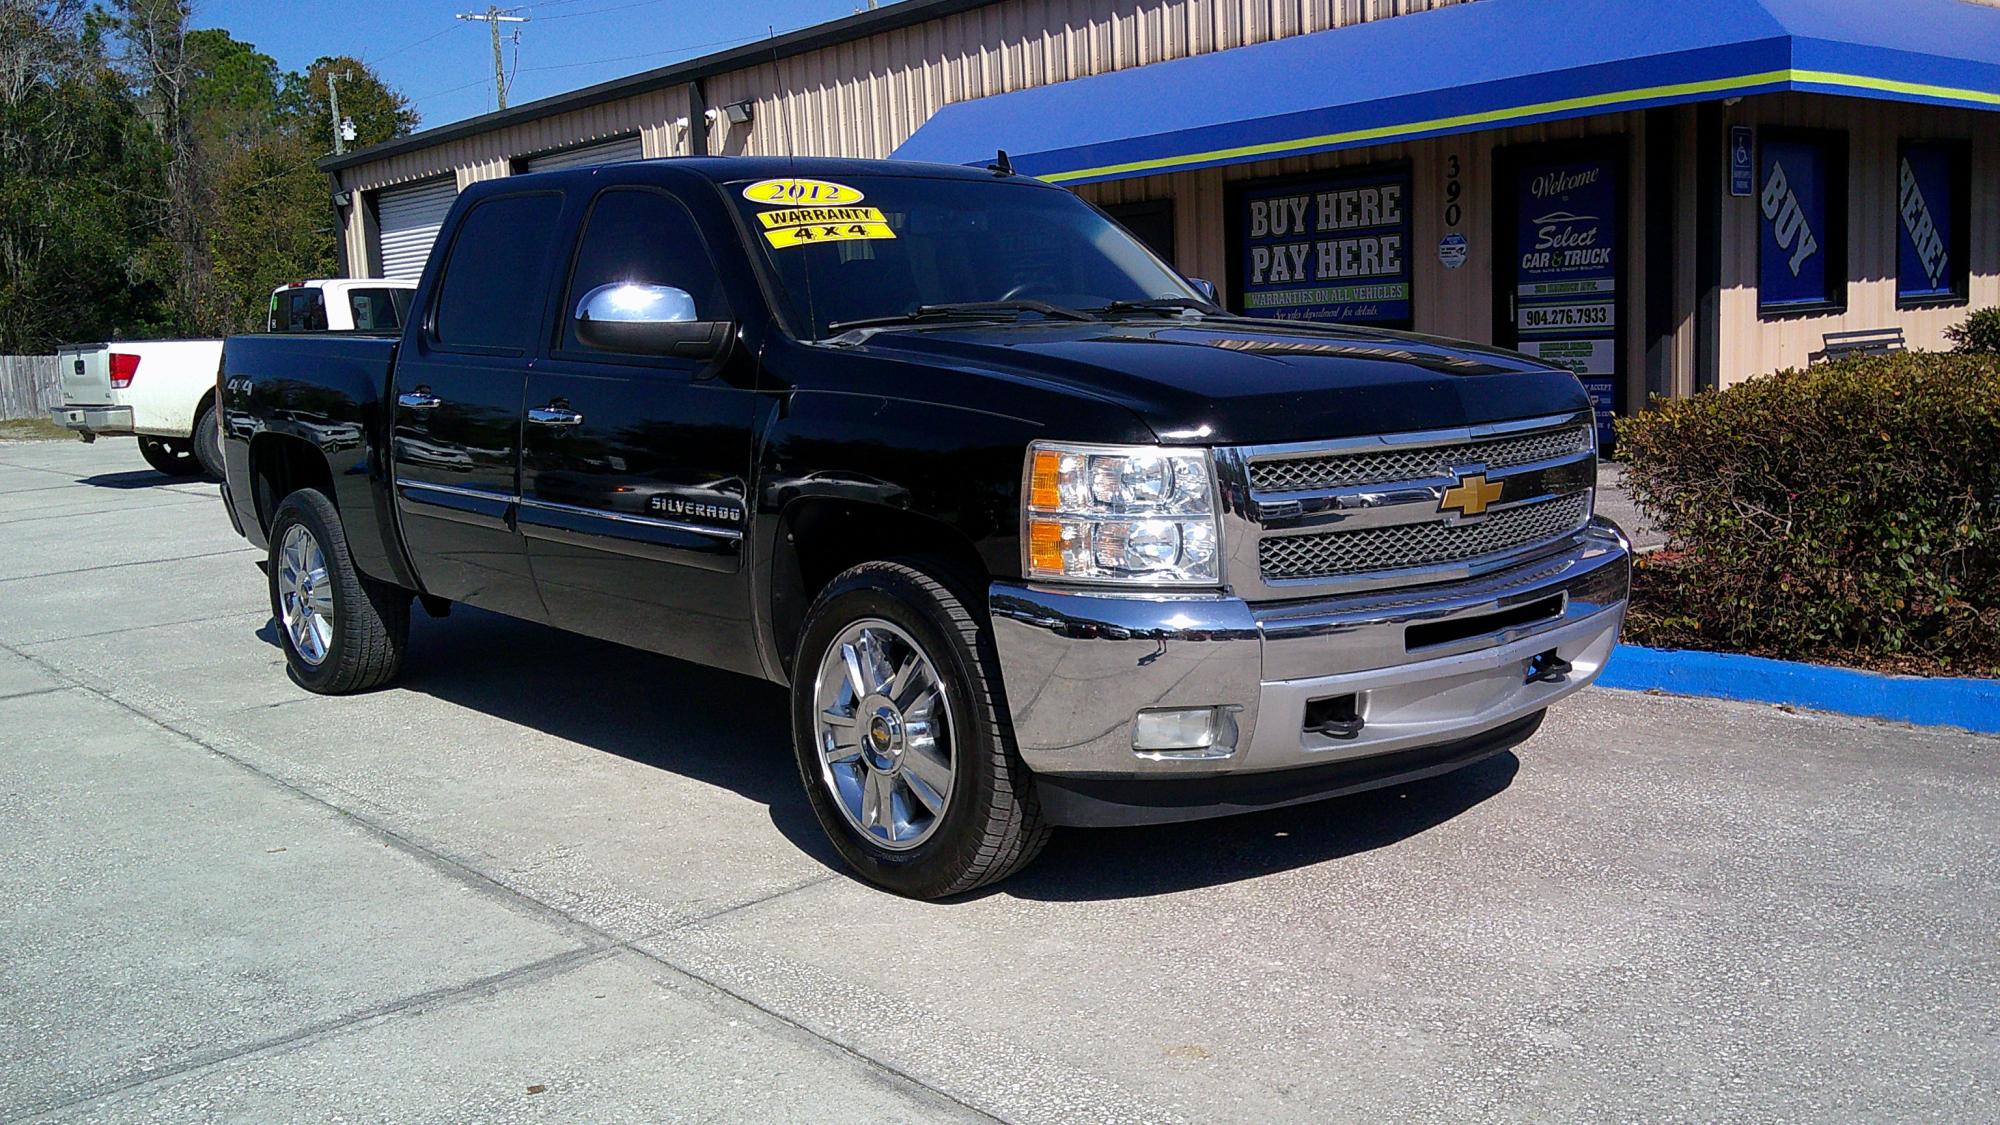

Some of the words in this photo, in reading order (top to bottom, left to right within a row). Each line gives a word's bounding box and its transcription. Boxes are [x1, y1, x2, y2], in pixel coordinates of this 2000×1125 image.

[769, 184, 840, 200] 2012
[1446, 154, 1461, 226] 390
[1531, 168, 1600, 199] Welcome
[769, 209, 873, 225] WARRANTY
[1251, 196, 1310, 238] BUY
[1316, 185, 1401, 231] HERE
[1762, 160, 1818, 277] BUY
[1535, 225, 1598, 250] Select
[1251, 244, 1310, 283] PAY
[1316, 235, 1401, 278] HERE
[1522, 252, 1551, 269] CAR
[1551, 251, 1563, 267] &
[1564, 247, 1612, 266] TRUCK
[1251, 293, 1314, 306] WARRANTIES
[1315, 290, 1329, 302] ON
[1330, 288, 1350, 301] ALL
[1352, 285, 1403, 300] VEHICLES
[1526, 307, 1607, 326] 904.276.7933
[1590, 384, 1613, 392] ACCEPT
[651, 497, 740, 521] SILVERADO
